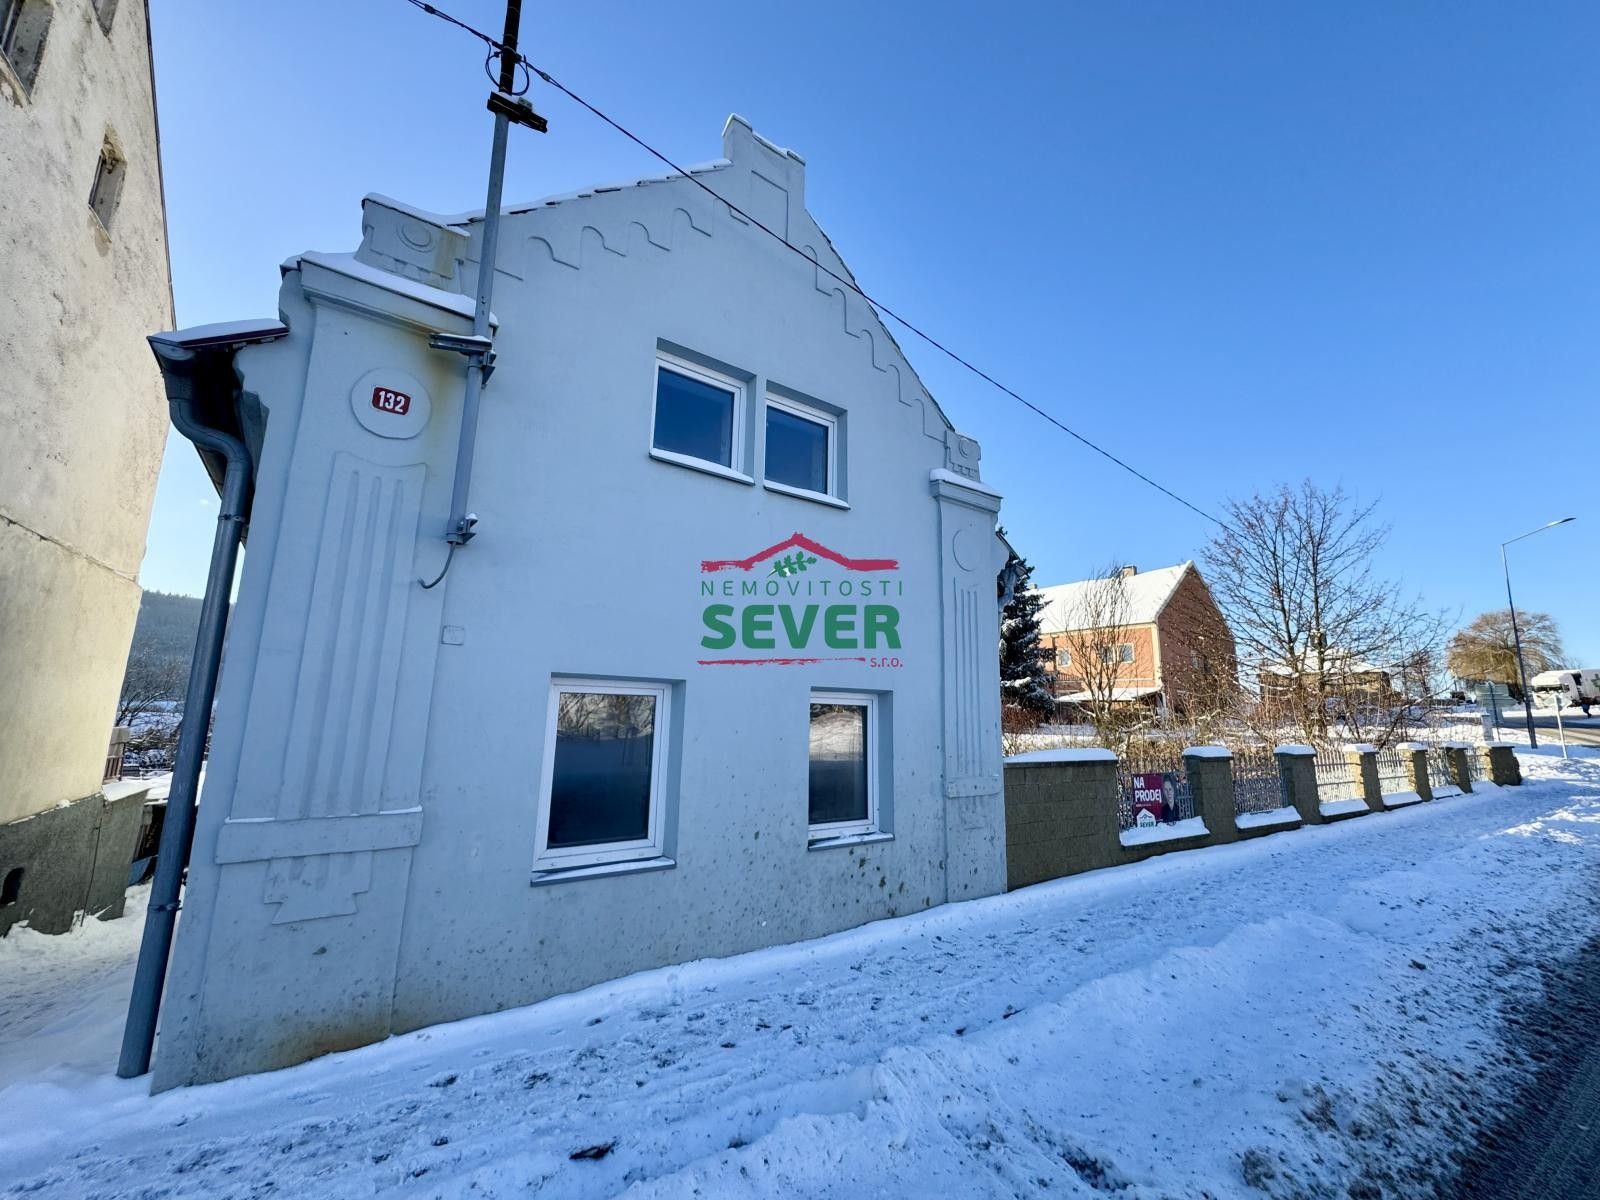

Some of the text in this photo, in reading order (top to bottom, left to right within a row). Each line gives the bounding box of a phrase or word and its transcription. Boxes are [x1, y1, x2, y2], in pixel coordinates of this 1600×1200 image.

[379, 390, 405, 412] 132
[1133, 776, 1145, 788] NA
[1135, 789, 1162, 803] PRODEJ
